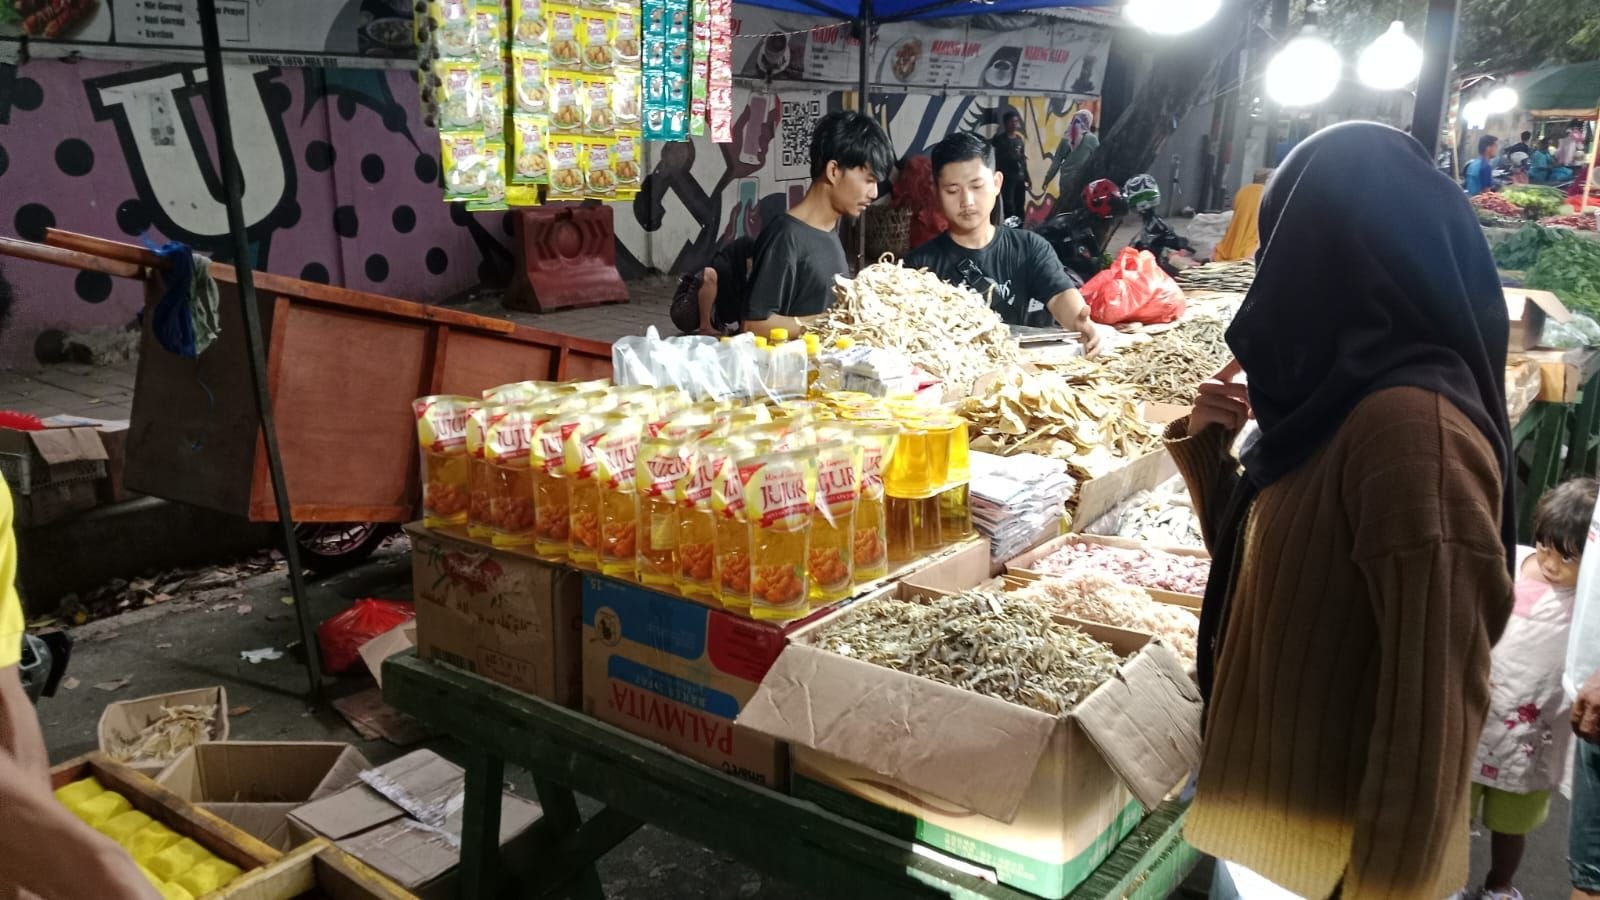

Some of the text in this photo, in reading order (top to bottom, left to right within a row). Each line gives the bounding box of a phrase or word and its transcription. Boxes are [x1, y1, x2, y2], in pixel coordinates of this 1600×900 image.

[158, 2, 183, 13] Goreng
[160, 16, 185, 27] Goreng
[496, 427, 531, 449] JUJU
[760, 478, 807, 510] JUJUR
[612, 683, 735, 756] PALMVITA
